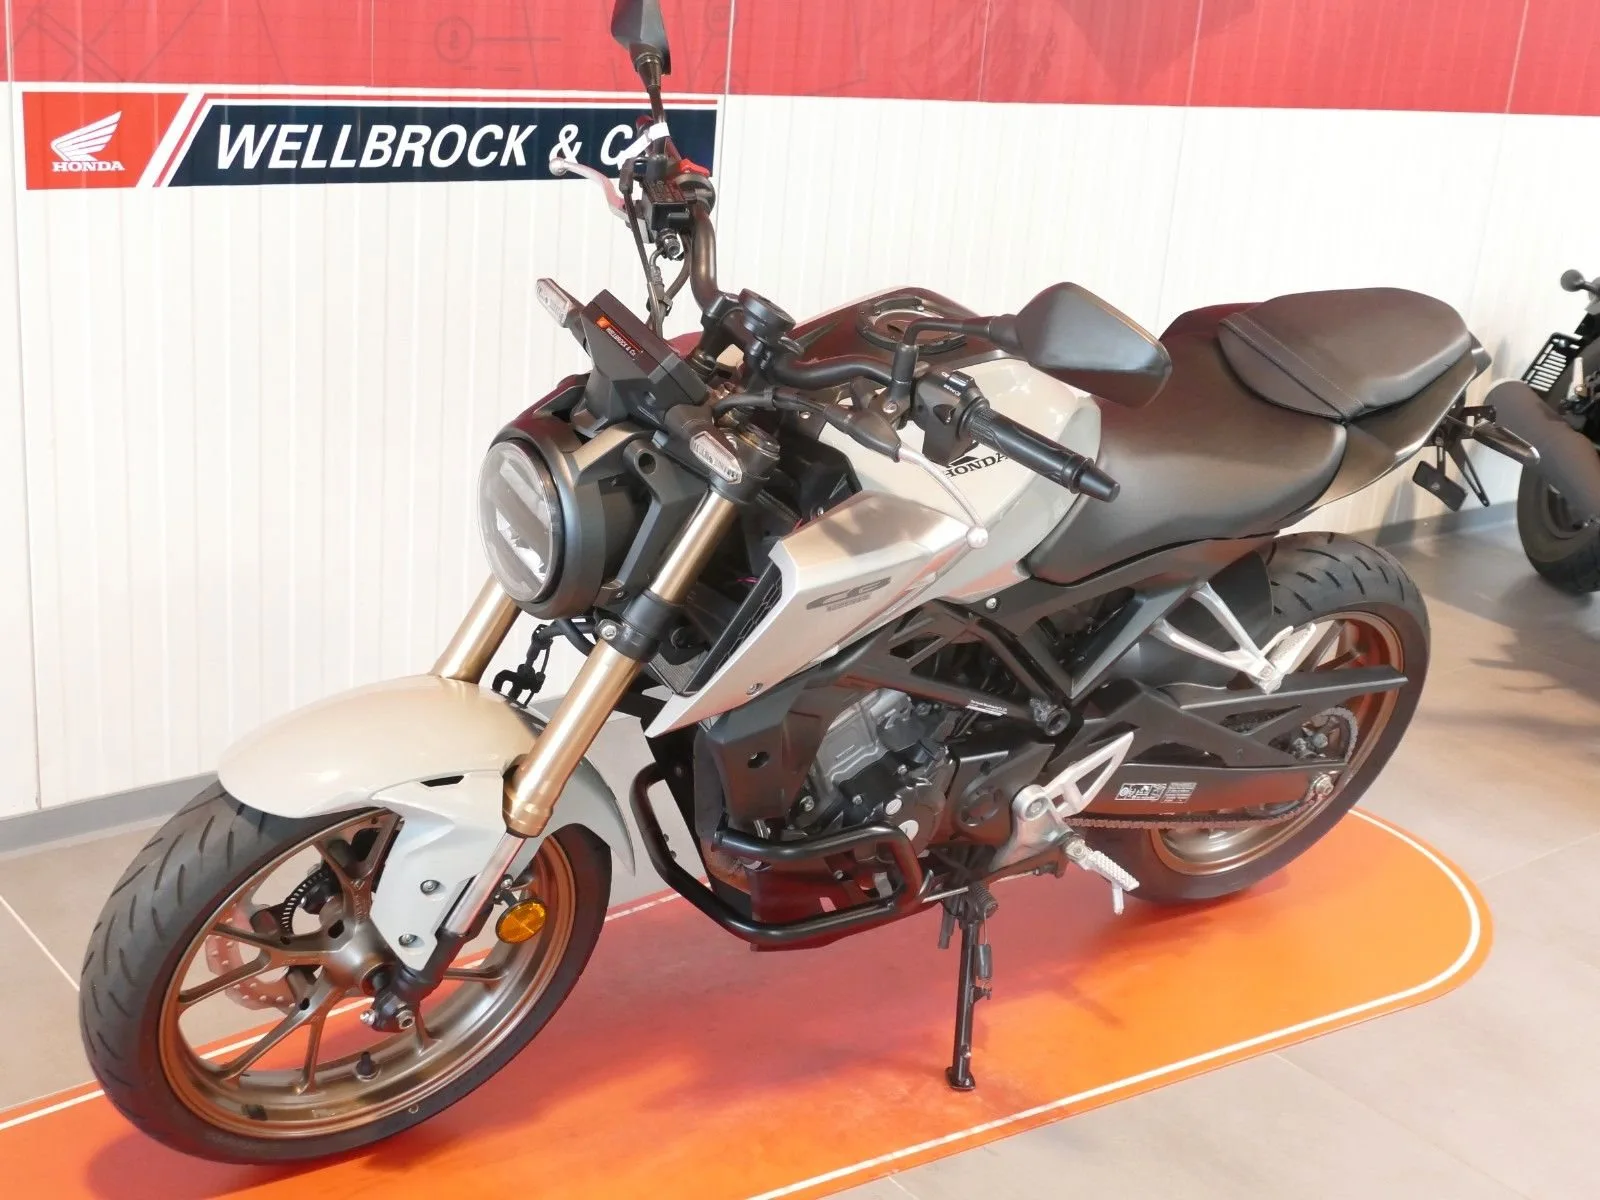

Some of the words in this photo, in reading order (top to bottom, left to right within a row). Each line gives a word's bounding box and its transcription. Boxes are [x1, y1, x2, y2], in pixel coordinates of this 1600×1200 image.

[217, 123, 538, 170] WELLBROCK
[549, 123, 583, 166] &
[51, 160, 126, 172] HONDA
